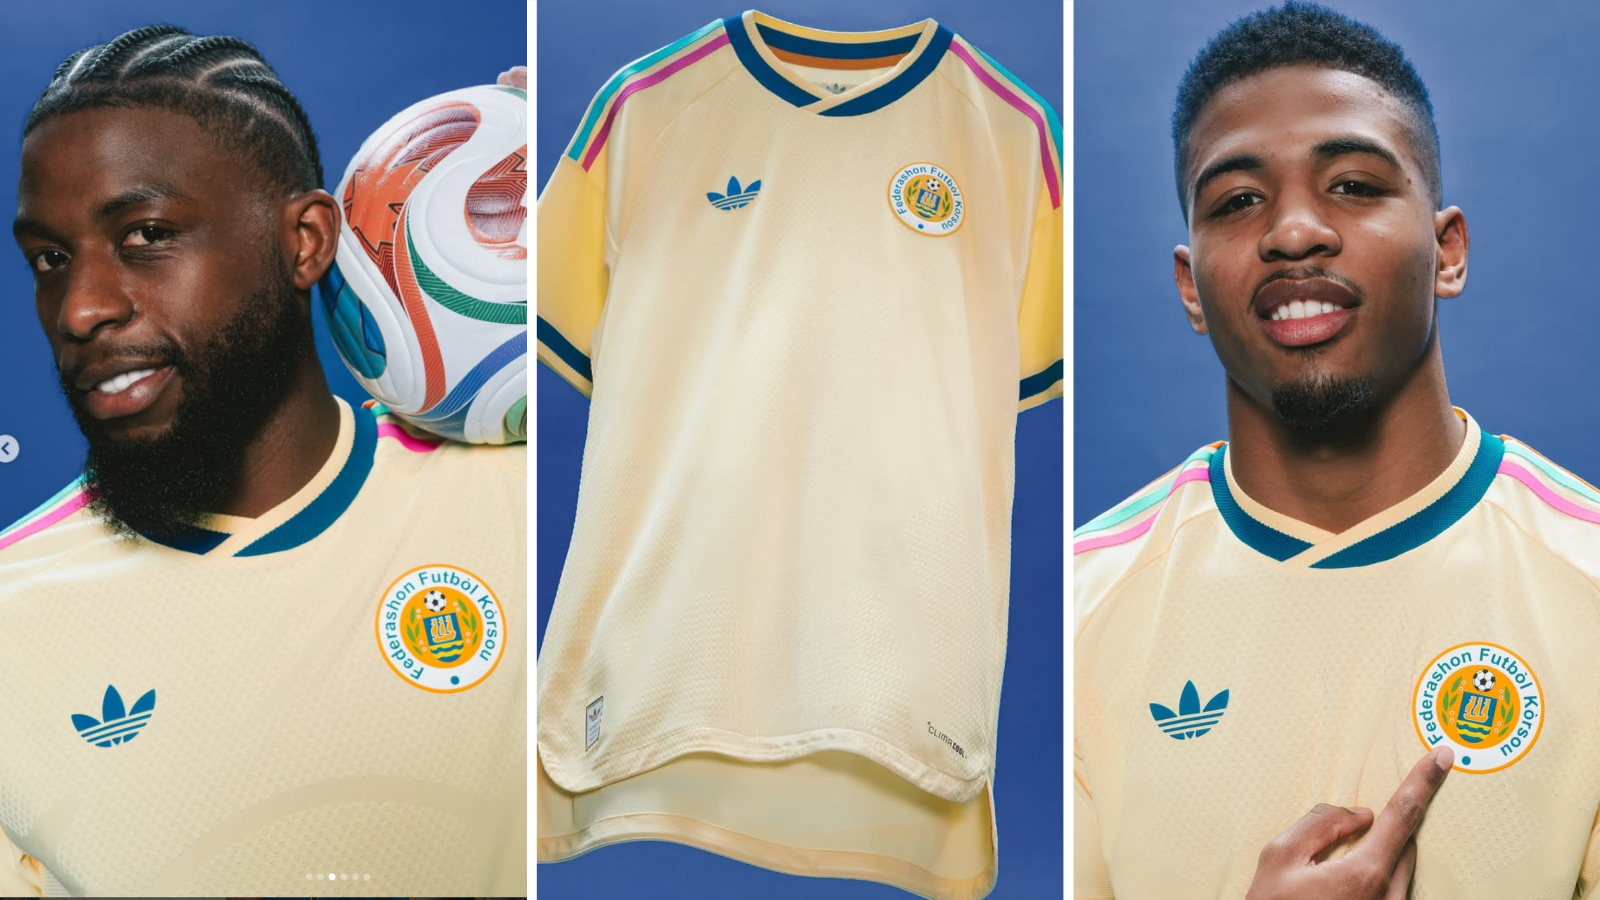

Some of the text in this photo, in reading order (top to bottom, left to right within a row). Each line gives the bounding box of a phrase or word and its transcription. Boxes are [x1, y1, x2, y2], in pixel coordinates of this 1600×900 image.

[892, 166, 927, 215] Federashon
[385, 581, 424, 680] Federashon
[418, 571, 479, 595] Futbòl
[1419, 647, 1539, 757] Federashon Futbòl Kòrsou
